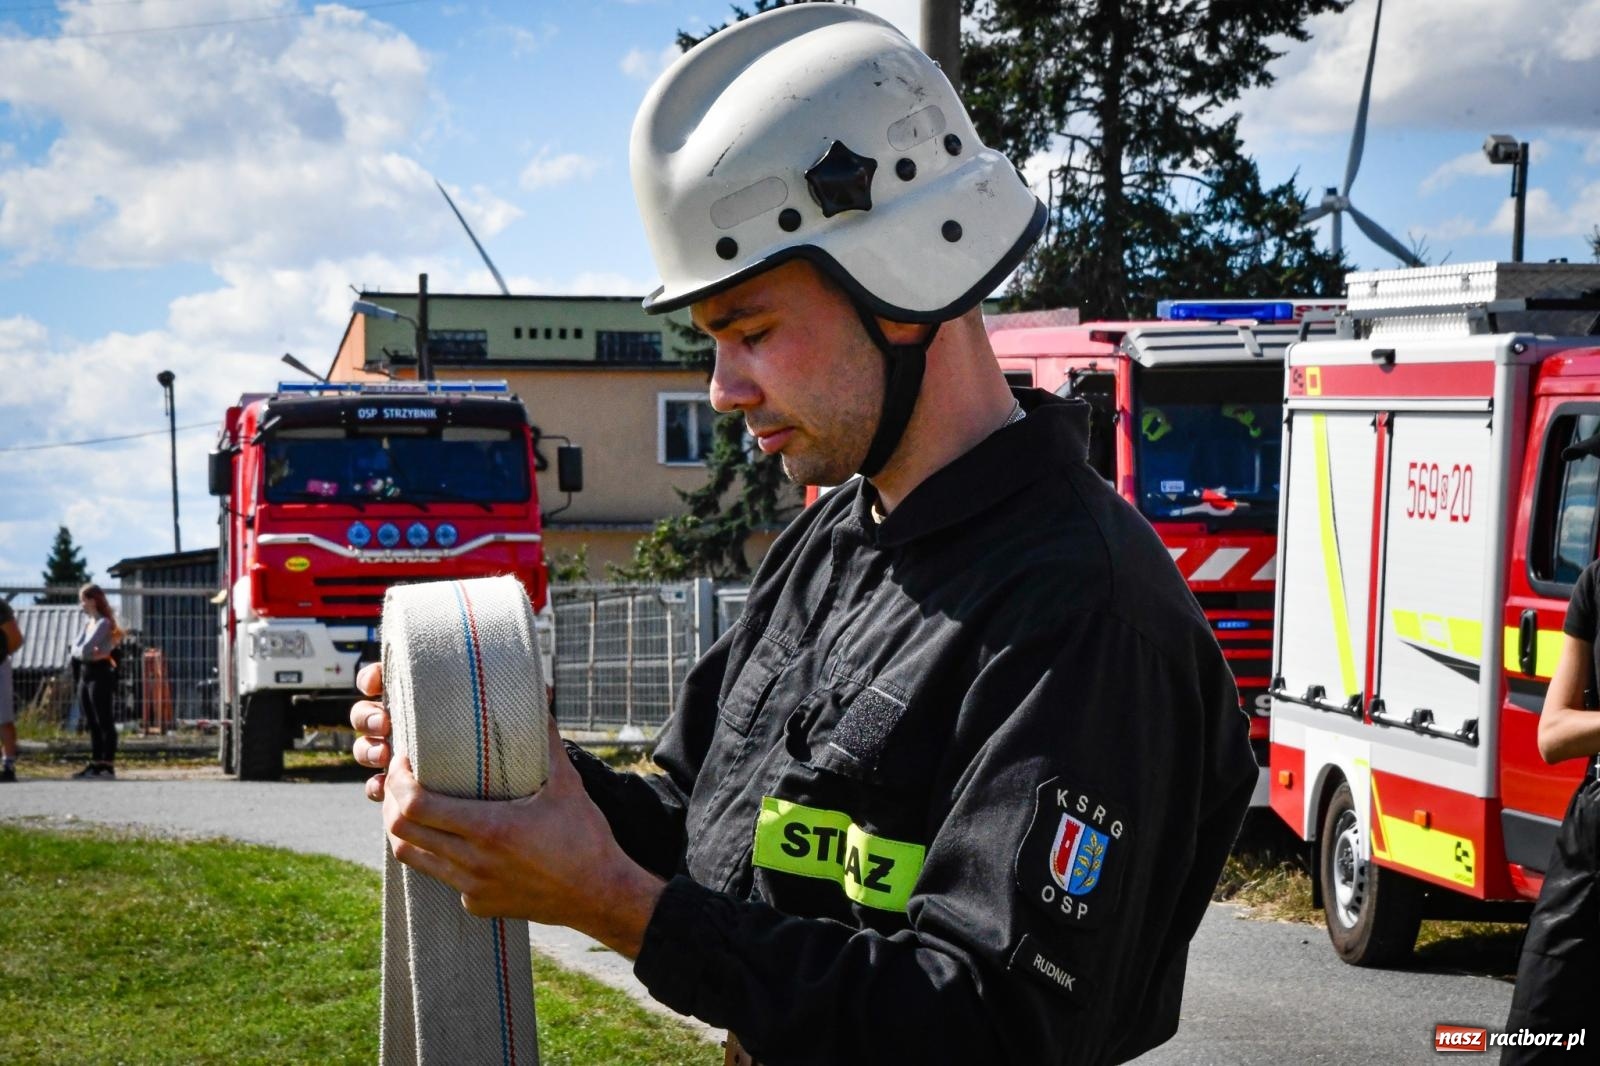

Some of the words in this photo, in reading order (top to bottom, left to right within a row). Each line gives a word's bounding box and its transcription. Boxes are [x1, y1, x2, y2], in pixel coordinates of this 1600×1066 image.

[357, 408, 378, 419] OSP
[383, 408, 437, 419] STRZYBNIK
[1056, 788, 1123, 840] KSRG
[1041, 885, 1088, 920] OSP
[1033, 953, 1077, 992] RUDNIK
